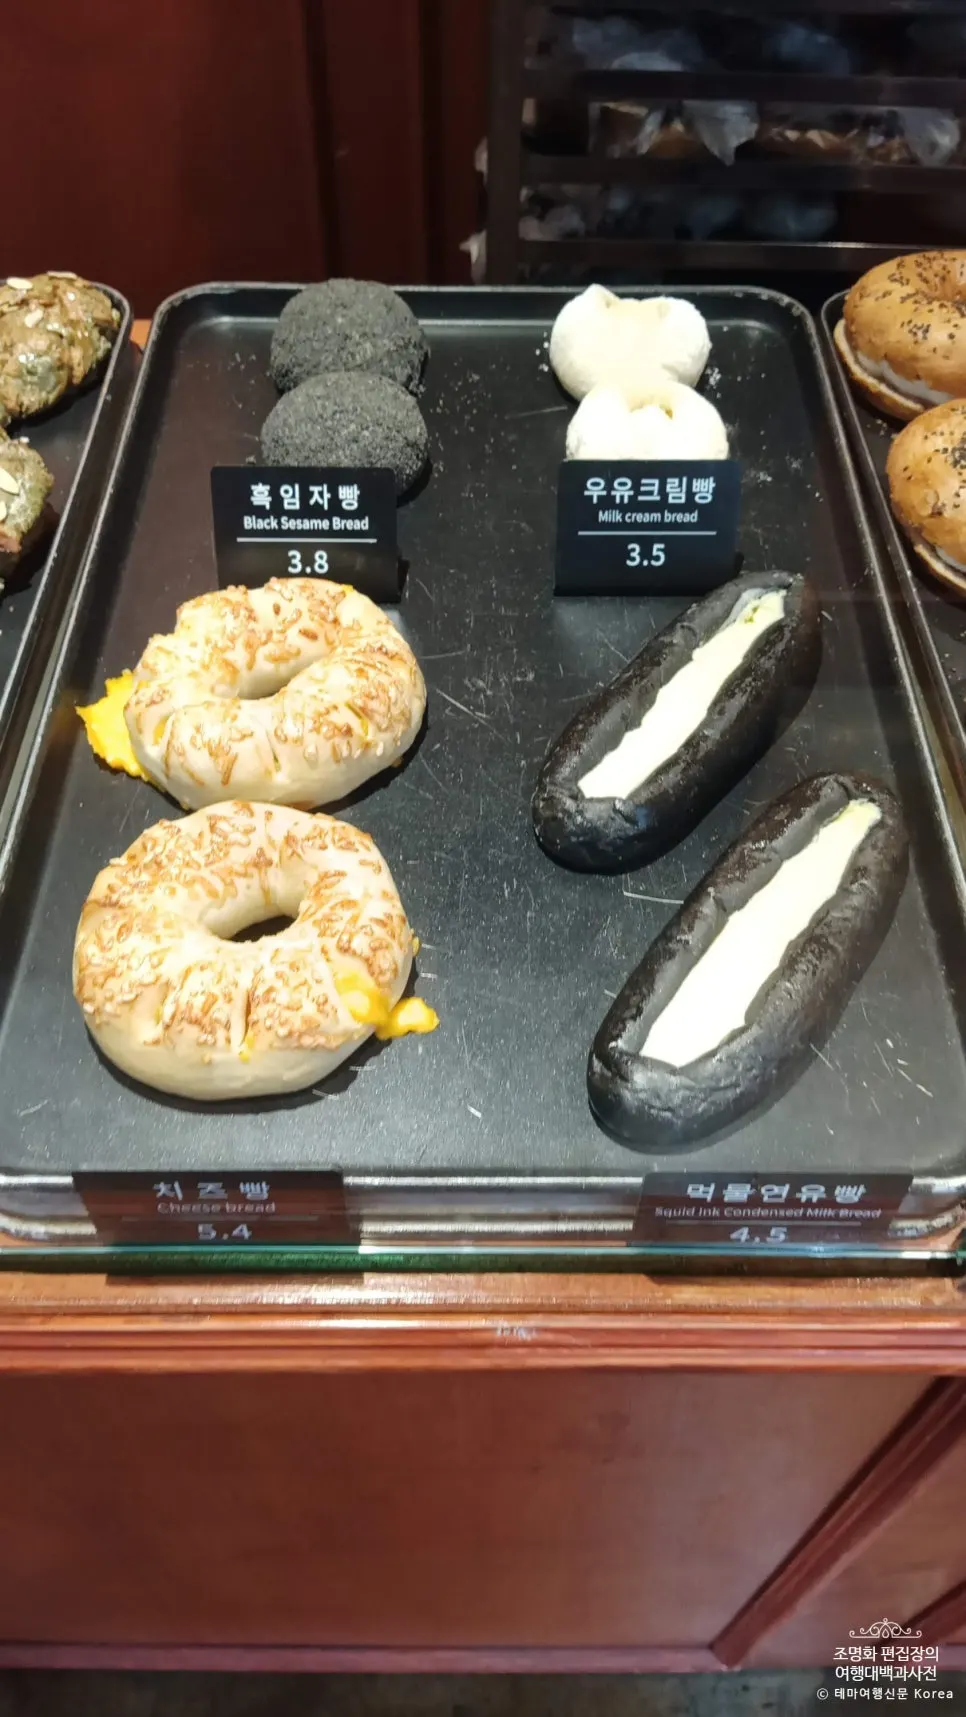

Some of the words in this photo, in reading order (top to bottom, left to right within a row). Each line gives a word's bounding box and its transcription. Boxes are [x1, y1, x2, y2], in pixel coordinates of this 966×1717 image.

[584, 476, 716, 504] 우유크림빵
[243, 515, 278, 530] Black
[280, 516, 330, 531] Sesame
[332, 516, 369, 531] Bread
[598, 509, 622, 523] Milk
[625, 512, 661, 523] cream
[664, 509, 698, 523] bread
[287, 550, 329, 574] 3.8
[626, 543, 666, 567] 3.5
[686, 1182, 867, 1204] 먹물연유빵
[157, 1201, 221, 1214] Cheese
[225, 1201, 276, 1213] bread
[655, 1206, 695, 1219] Squid
[698, 1206, 720, 1217] Ink
[724, 1206, 804, 1218] Condensed
[806, 1206, 834, 1218] Milk
[838, 1207, 882, 1219] Bread
[197, 1223, 252, 1241] 5.4
[730, 1226, 788, 1244] 4.5
